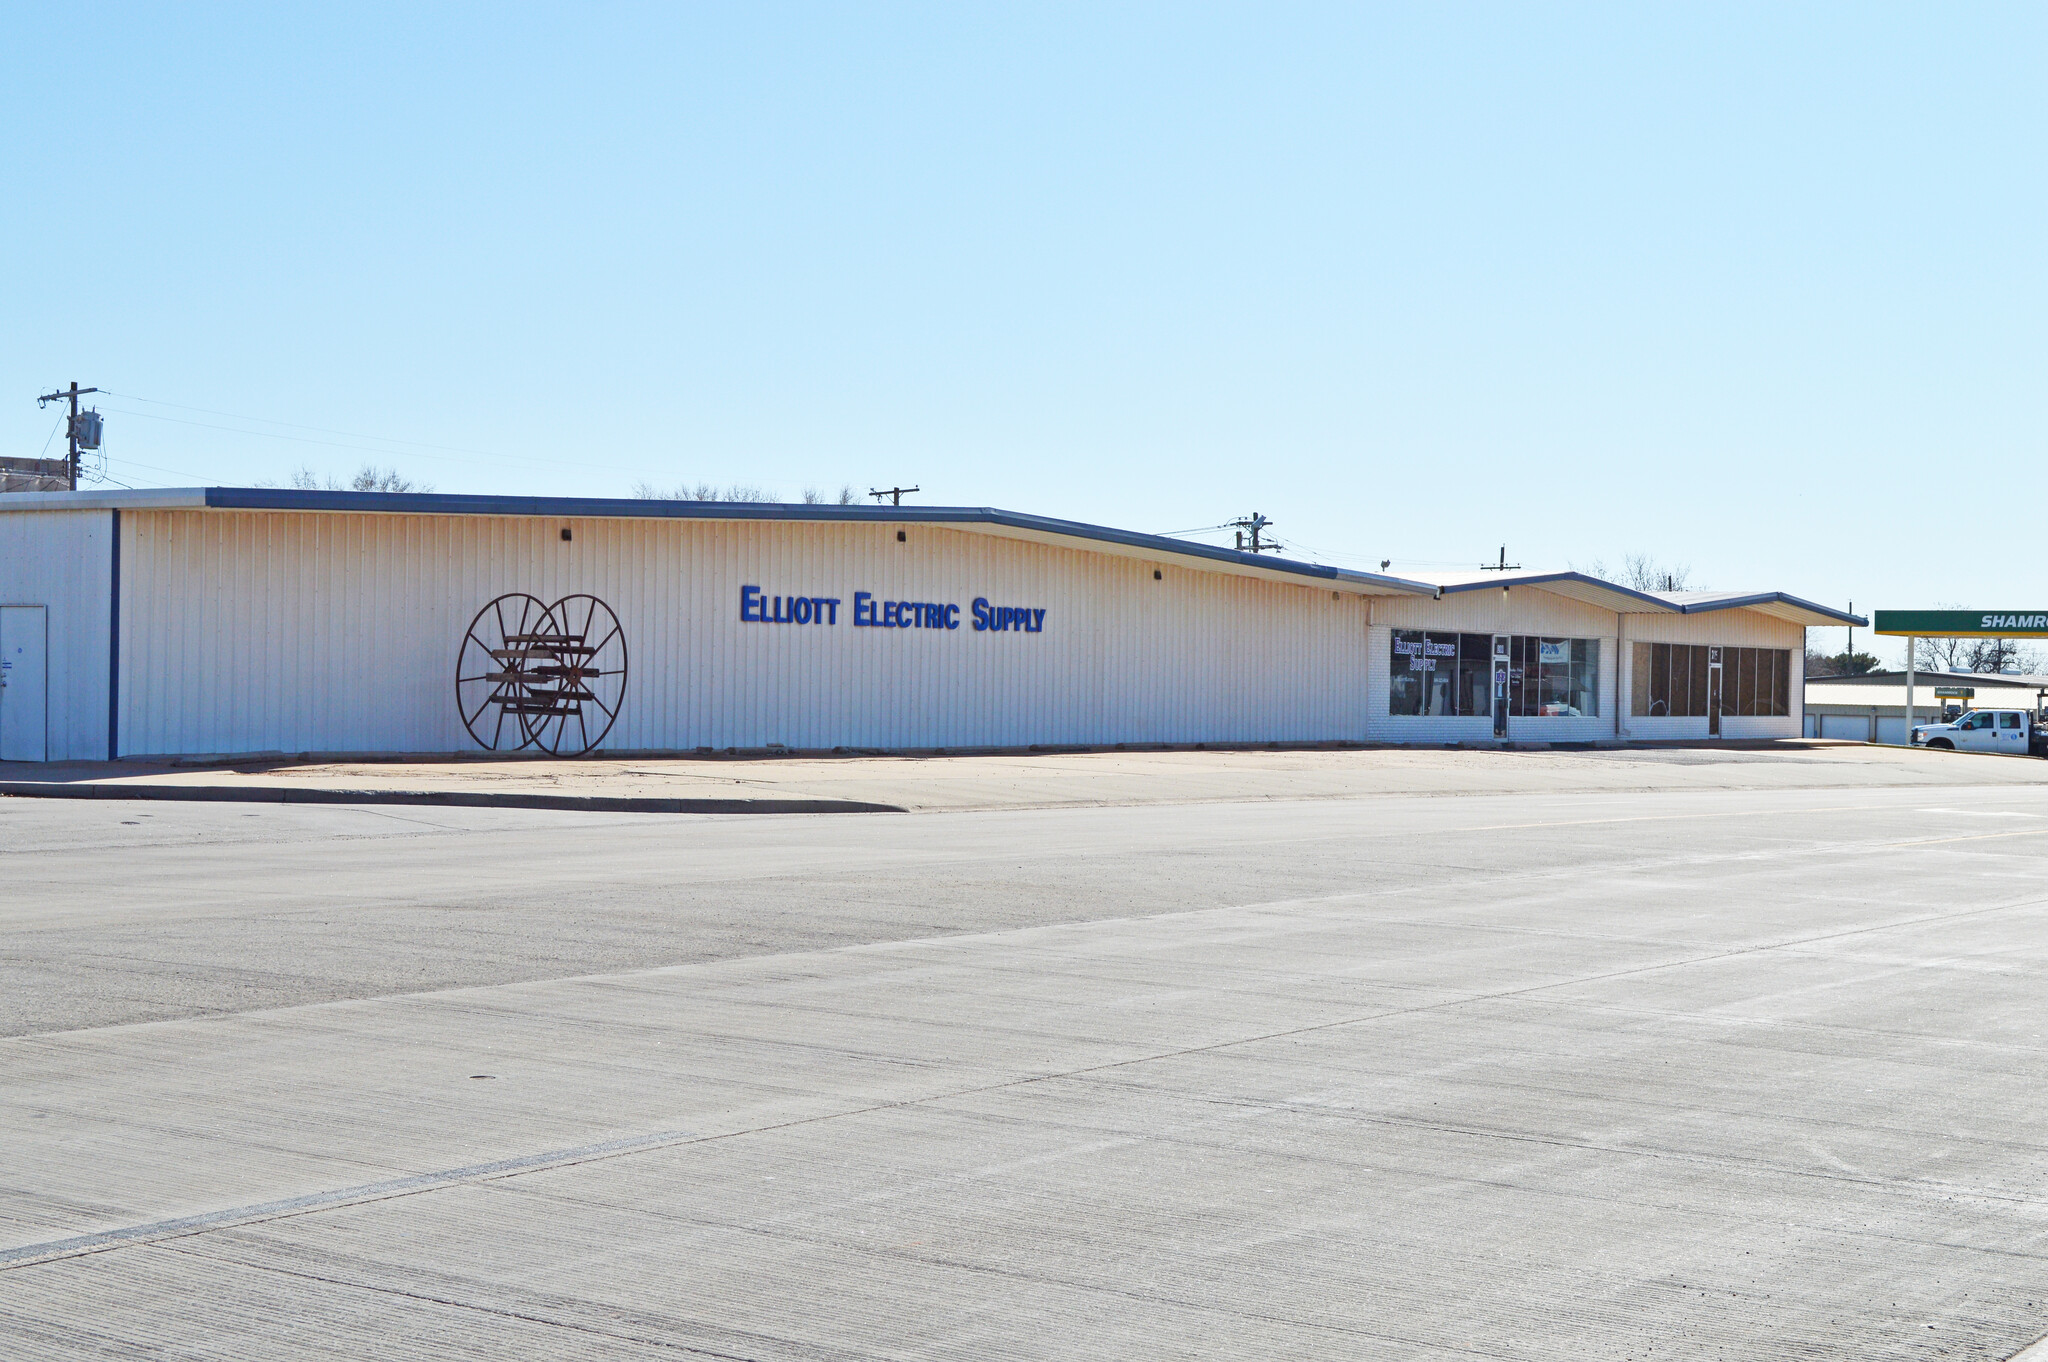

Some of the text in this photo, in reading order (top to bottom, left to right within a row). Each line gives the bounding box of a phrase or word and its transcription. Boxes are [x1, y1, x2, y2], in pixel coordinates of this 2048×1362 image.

[741, 585, 1046, 633] ELLIOTT ELECTRIC SUPPLY
[1981, 615, 2048, 628] SHAMR
[1394, 637, 1455, 656] ELLIOTT ELECTRIC
[1409, 654, 1437, 671] SUPPLY
